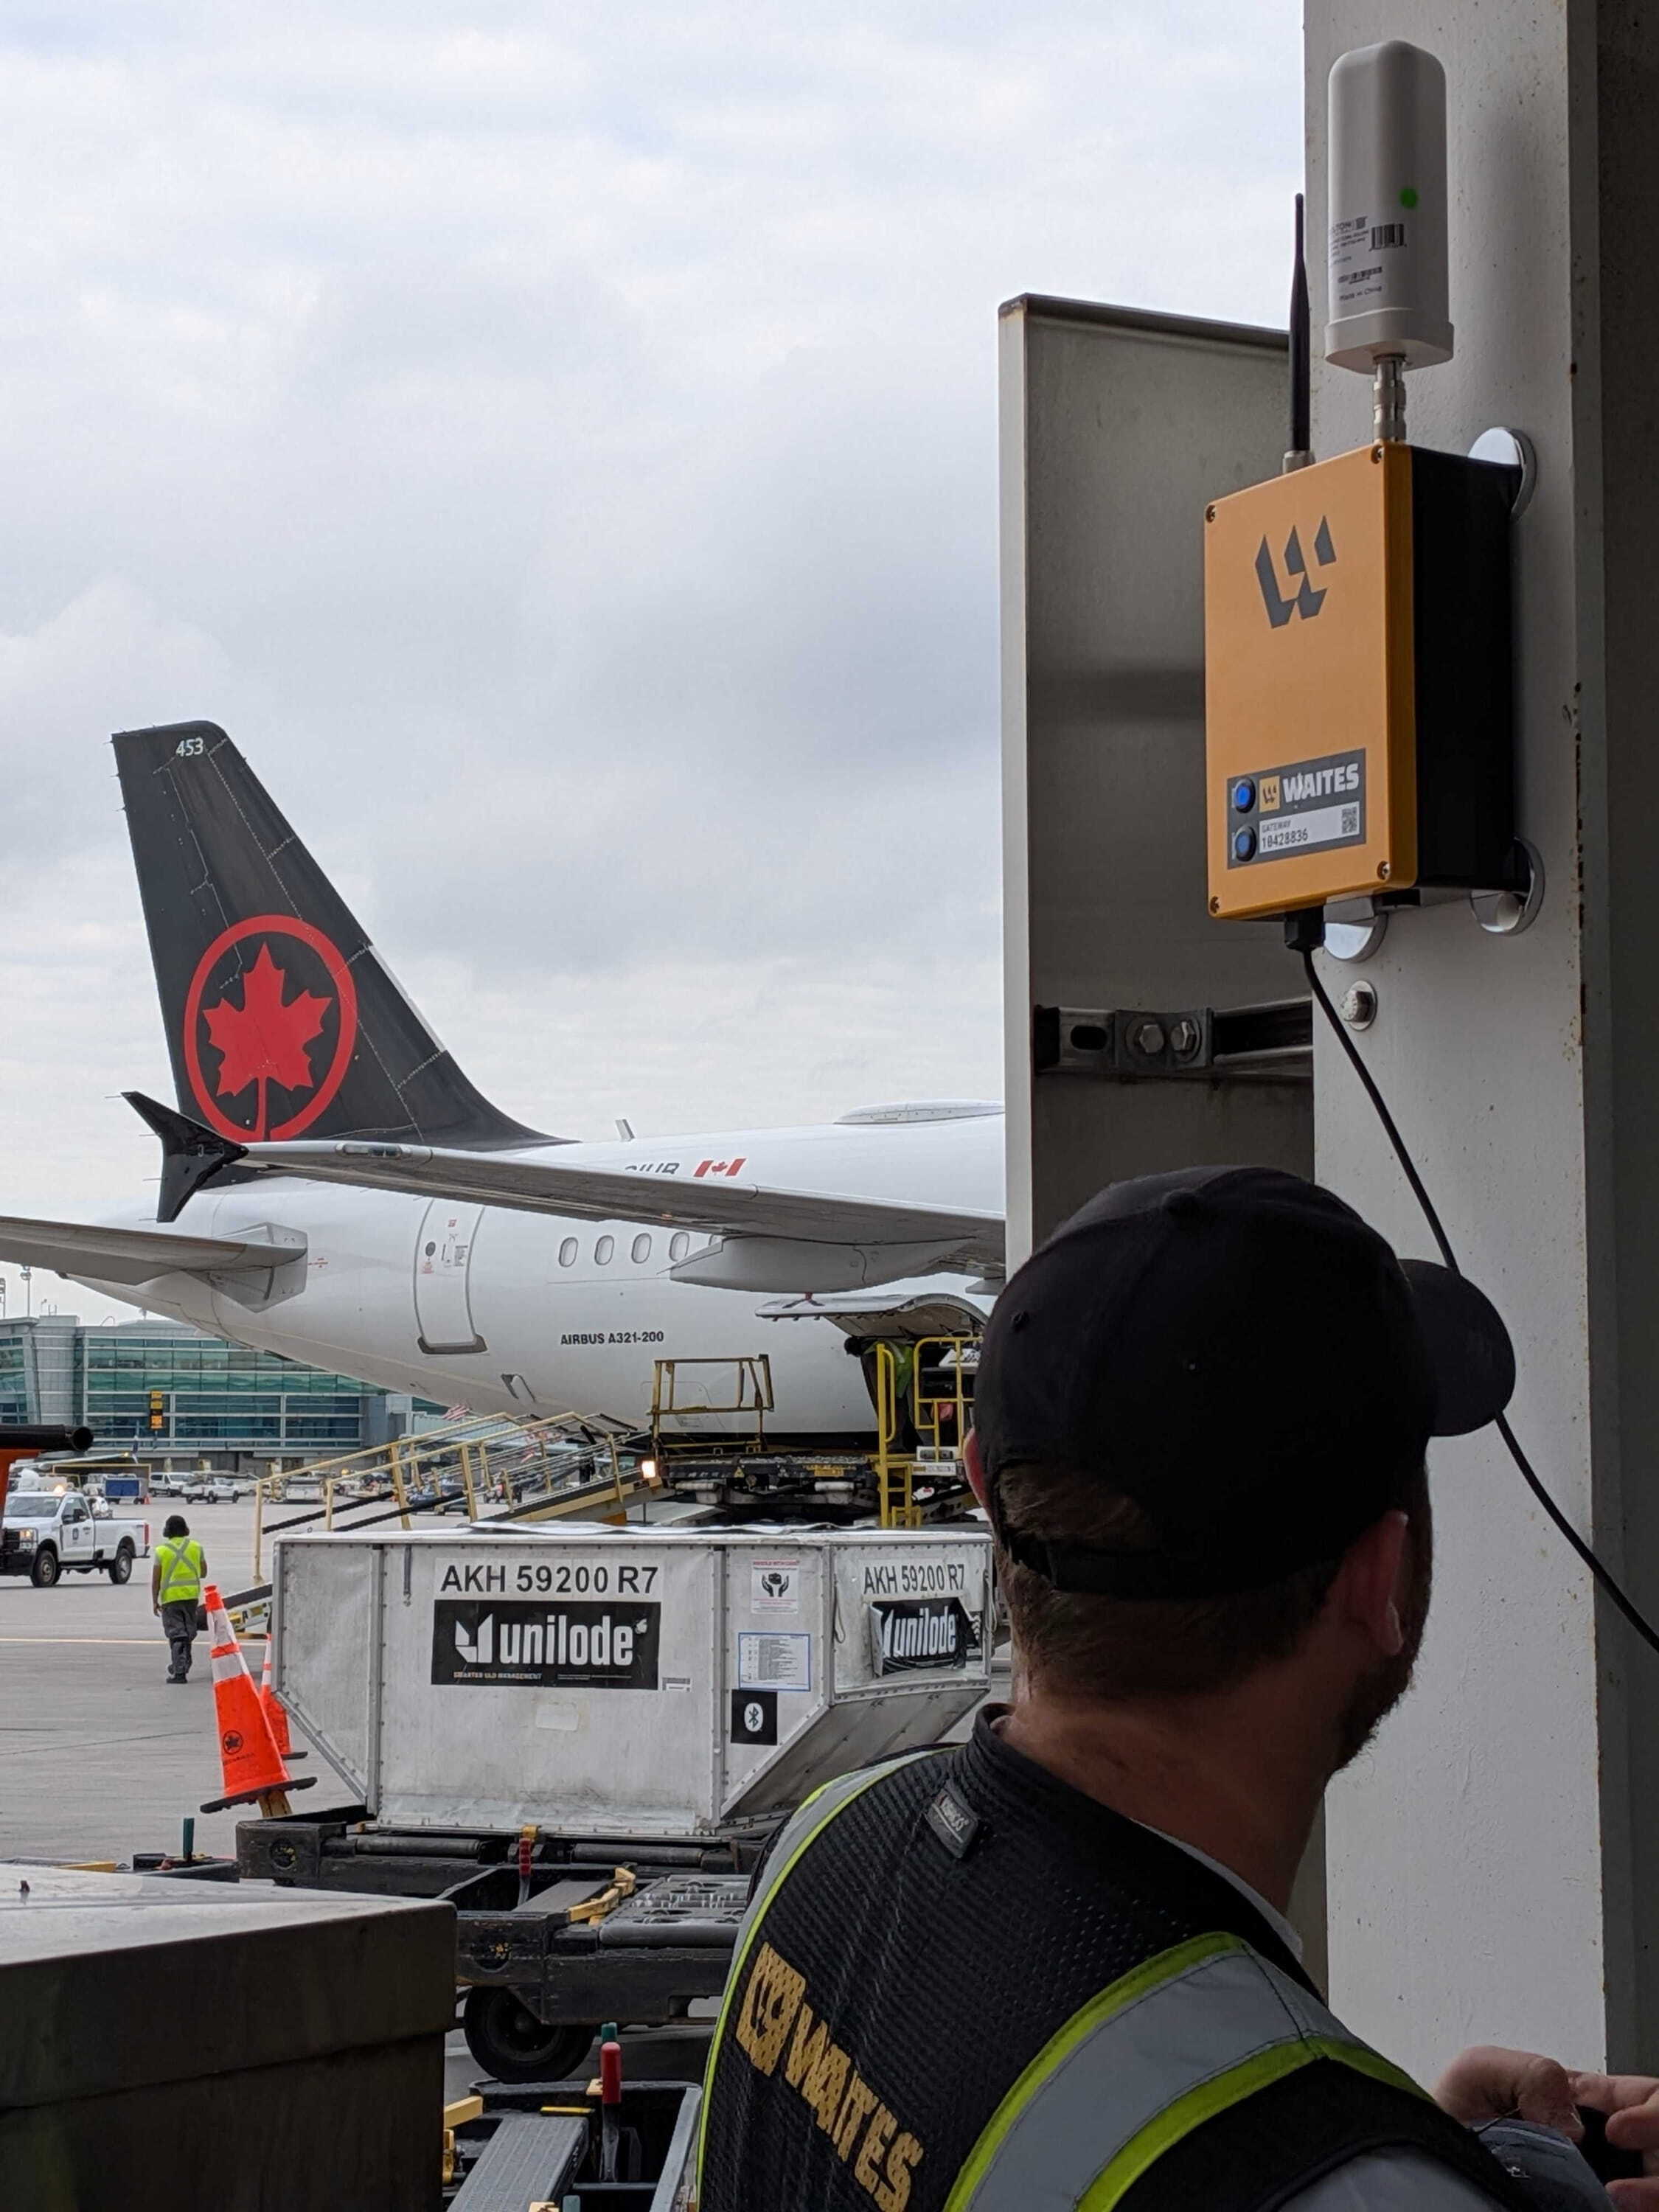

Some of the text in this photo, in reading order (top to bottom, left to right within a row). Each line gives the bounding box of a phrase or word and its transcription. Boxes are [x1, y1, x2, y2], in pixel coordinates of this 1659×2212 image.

[175, 737, 204, 757] 453
[1281, 762, 1360, 803] WAITES
[1261, 819, 1291, 833] GATEWAY
[560, 1330, 664, 1345] AIRBUS A321-200
[440, 1564, 659, 1593] AKH 59200 R7
[863, 1563, 965, 1594] AKH 59200 R7
[498, 1614, 633, 1666] unilode
[892, 1605, 957, 1658] unilode
[785, 2001, 925, 2212] WAITES
